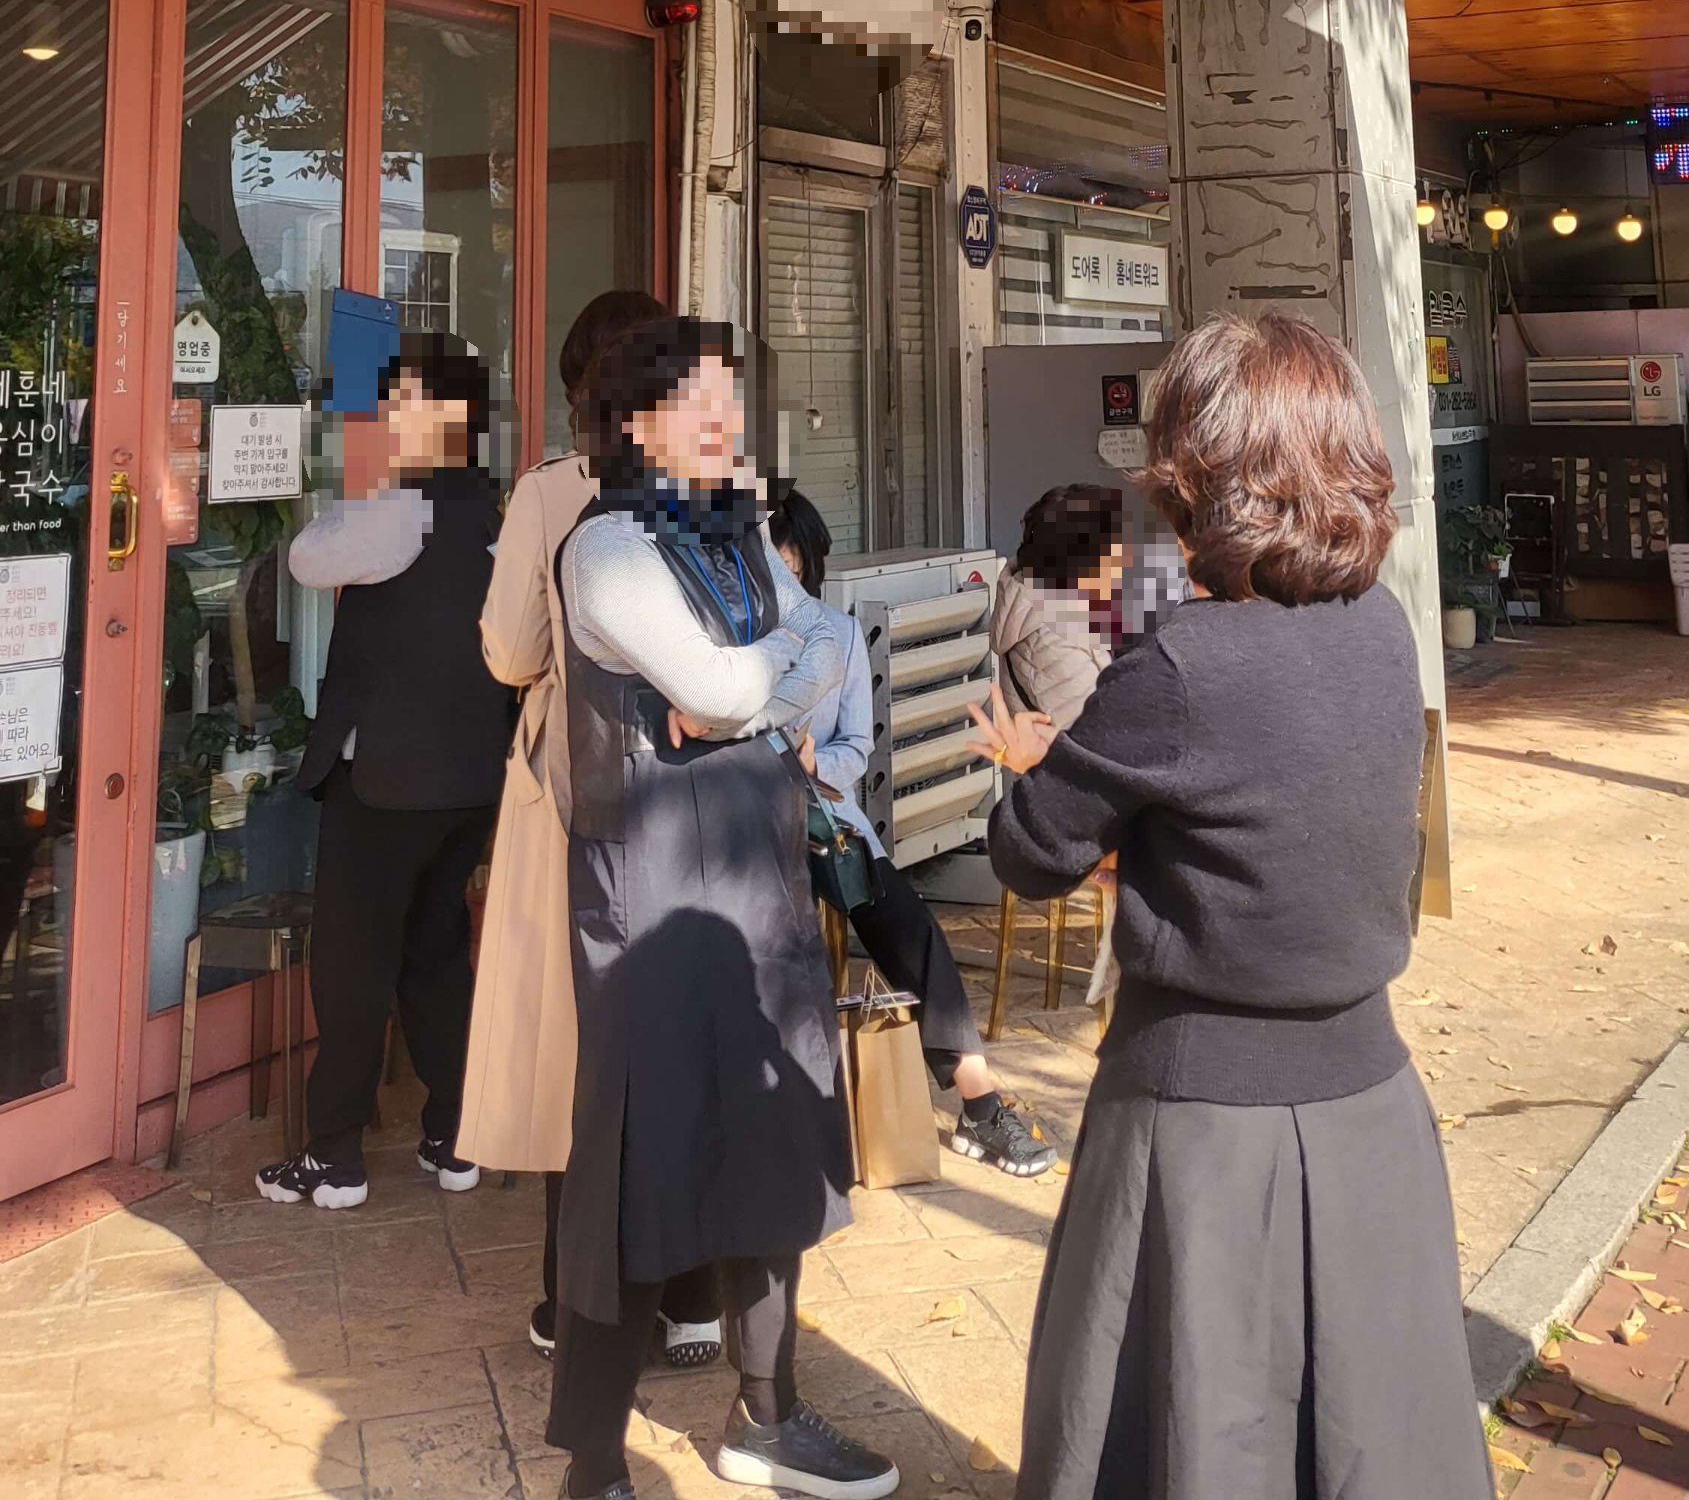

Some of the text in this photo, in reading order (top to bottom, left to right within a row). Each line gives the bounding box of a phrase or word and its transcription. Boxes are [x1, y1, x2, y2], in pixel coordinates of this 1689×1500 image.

[965, 212, 990, 242] ADT
[1071, 255, 1160, 289] 도어록 홈네트워크
[113, 309, 130, 394] 당기세요
[177, 340, 211, 358] 영업중
[1643, 385, 1662, 397] LG
[241, 433, 282, 446] 대기 발생 시
[234, 449, 249, 461] 주변
[267, 448, 289, 460] 입구를
[233, 463, 249, 476] 막지
[222, 478, 259, 491] 찾아주셔서
[12, 520, 36, 533] than
[39, 517, 62, 530] food
[6, 585, 48, 605] 정리되면
[7, 726, 30, 743] 따라
